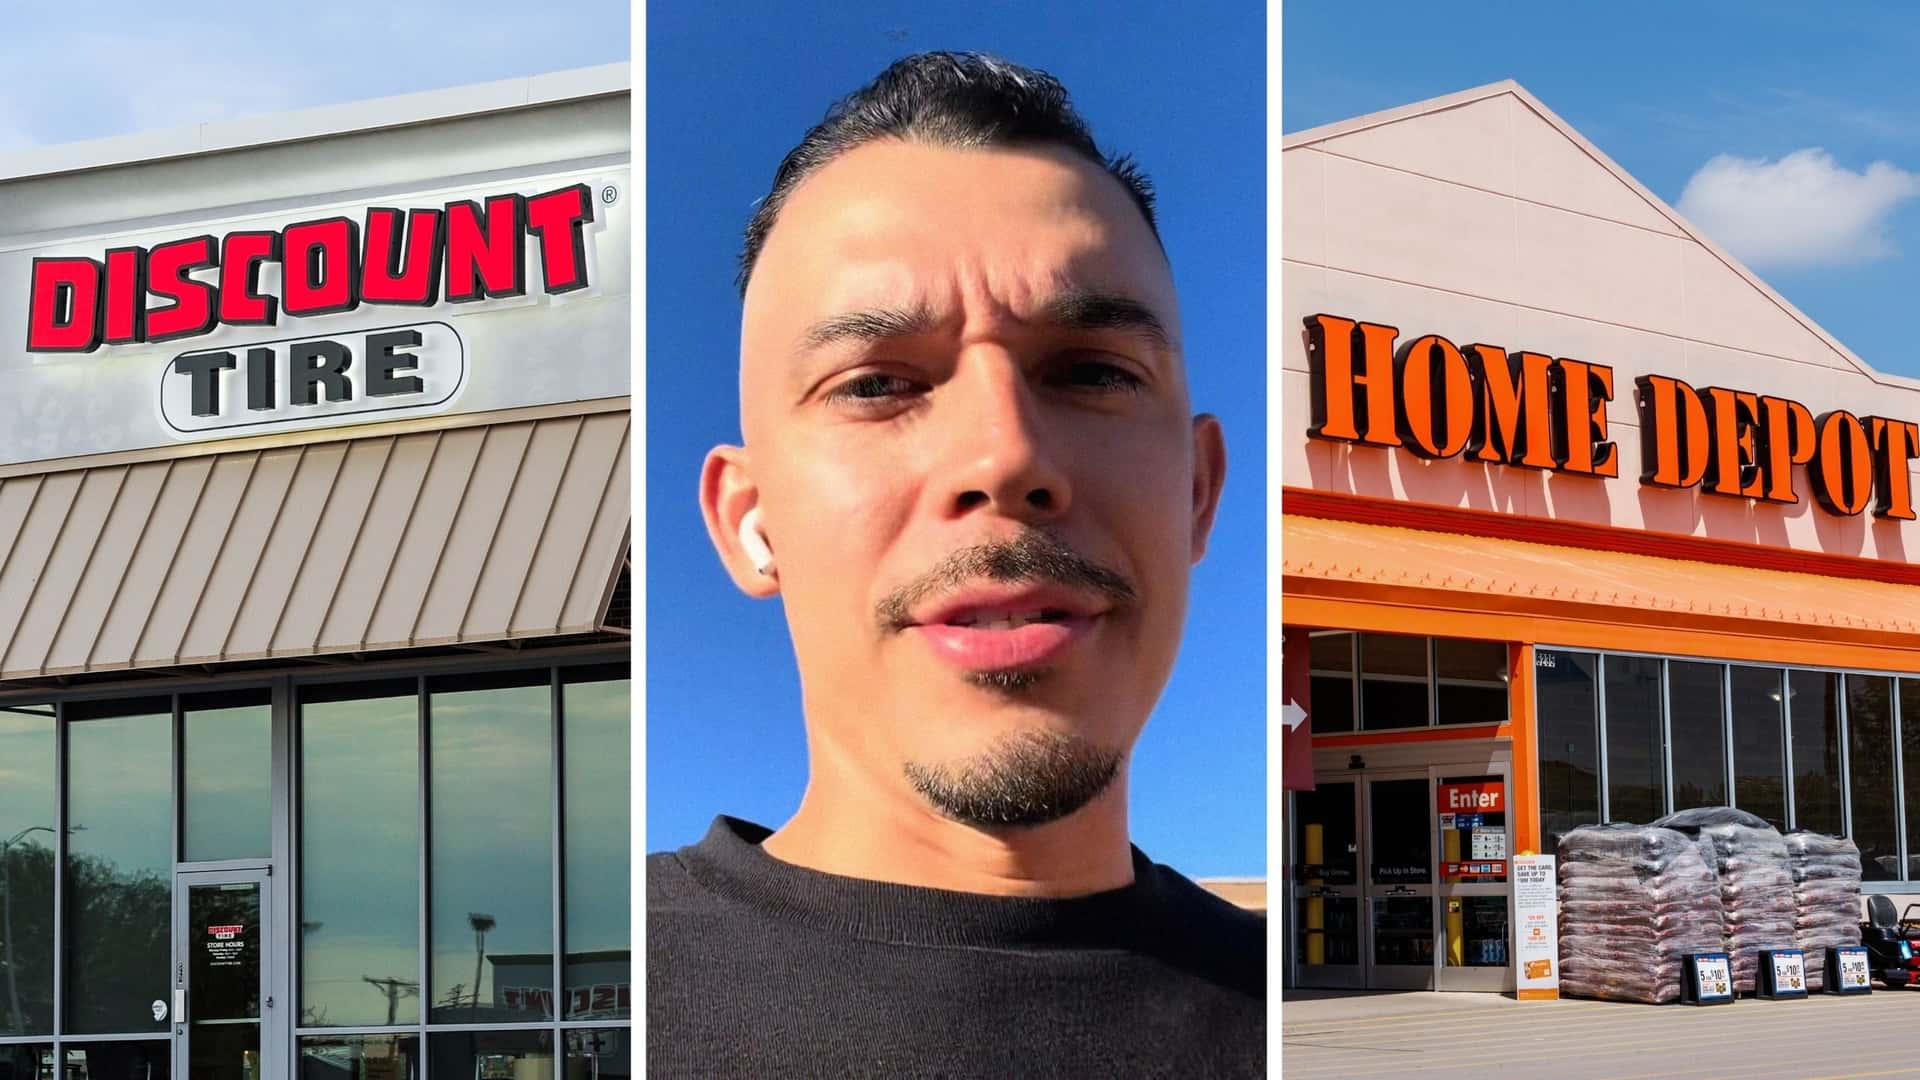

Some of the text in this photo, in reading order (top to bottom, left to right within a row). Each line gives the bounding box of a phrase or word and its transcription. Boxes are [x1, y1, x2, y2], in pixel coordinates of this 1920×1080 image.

[26, 183, 594, 353] DISCOUNT
[174, 330, 423, 417] TIRE
[1303, 313, 1920, 520] HOME DEPOT
[1449, 788, 1499, 809] Enter
[1700, 970, 1706, 981] 5
[1776, 965, 1781, 976] 5
[1842, 962, 1847, 973] 5
